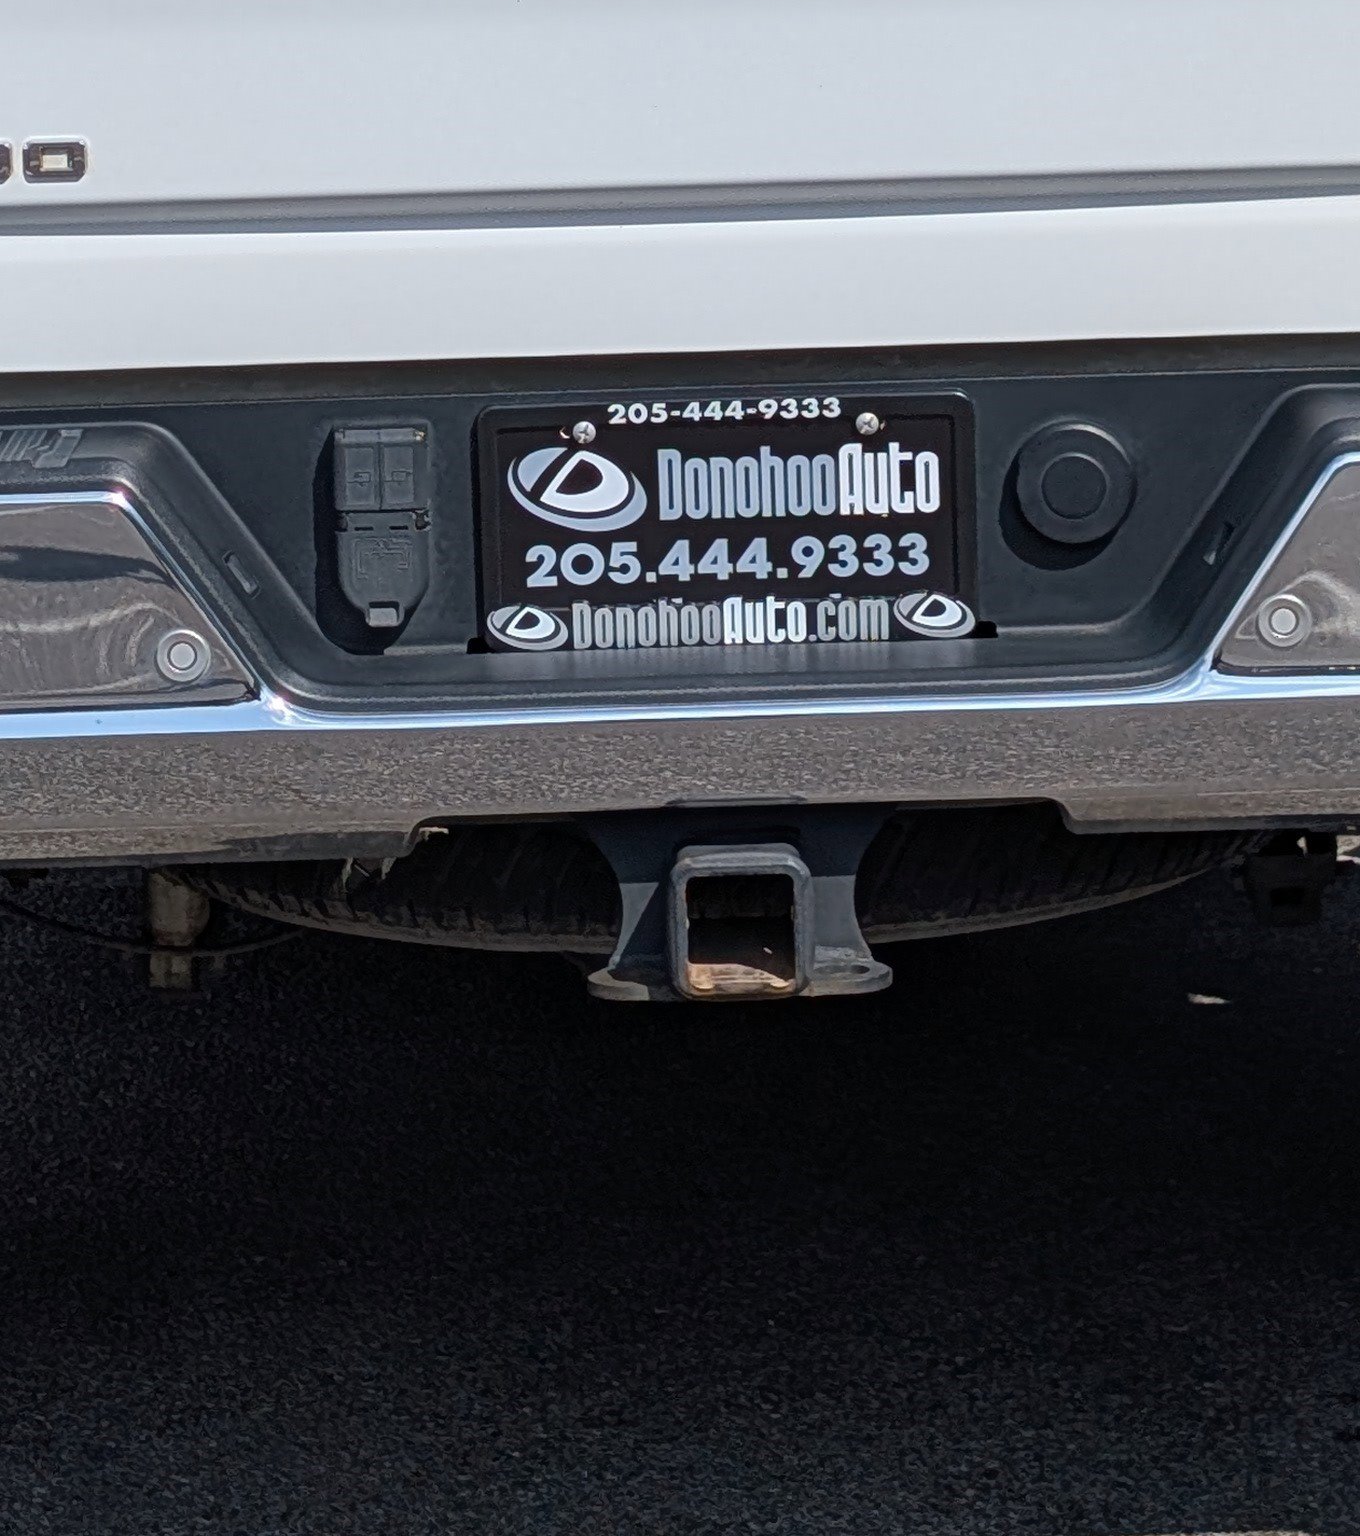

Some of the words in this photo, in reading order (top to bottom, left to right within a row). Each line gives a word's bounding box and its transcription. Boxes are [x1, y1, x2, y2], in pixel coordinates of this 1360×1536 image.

[607, 396, 842, 425] 205-444-9333
[658, 442, 941, 521] DonohooAuto
[525, 532, 930, 590] 205.444.9333
[571, 596, 890, 650] DonohooAuto.com
